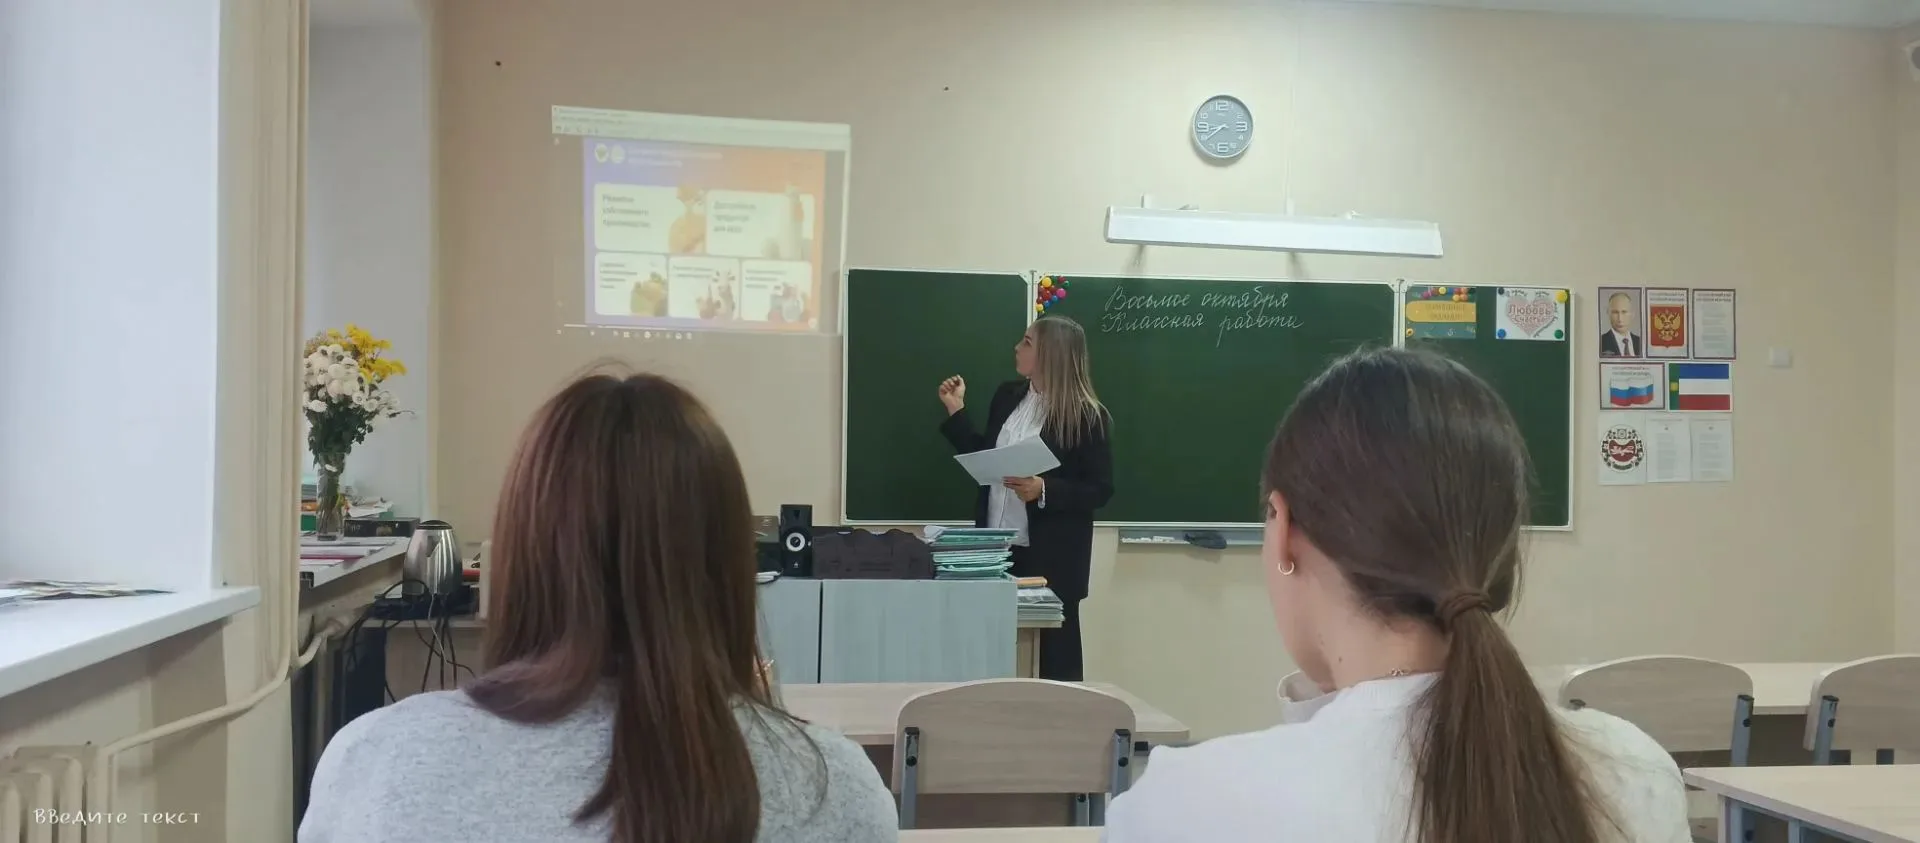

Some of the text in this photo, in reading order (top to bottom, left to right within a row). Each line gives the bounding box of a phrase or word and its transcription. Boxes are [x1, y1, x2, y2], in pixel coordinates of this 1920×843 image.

[1215, 100, 1229, 111] 12
[1197, 121, 1209, 133] 9
[1235, 121, 1248, 132] 3
[1217, 142, 1229, 153] 6
[1104, 285, 1289, 320] Восьмое октября
[1508, 303, 1551, 315] Любовь
[1102, 309, 1305, 347] Классная работа
